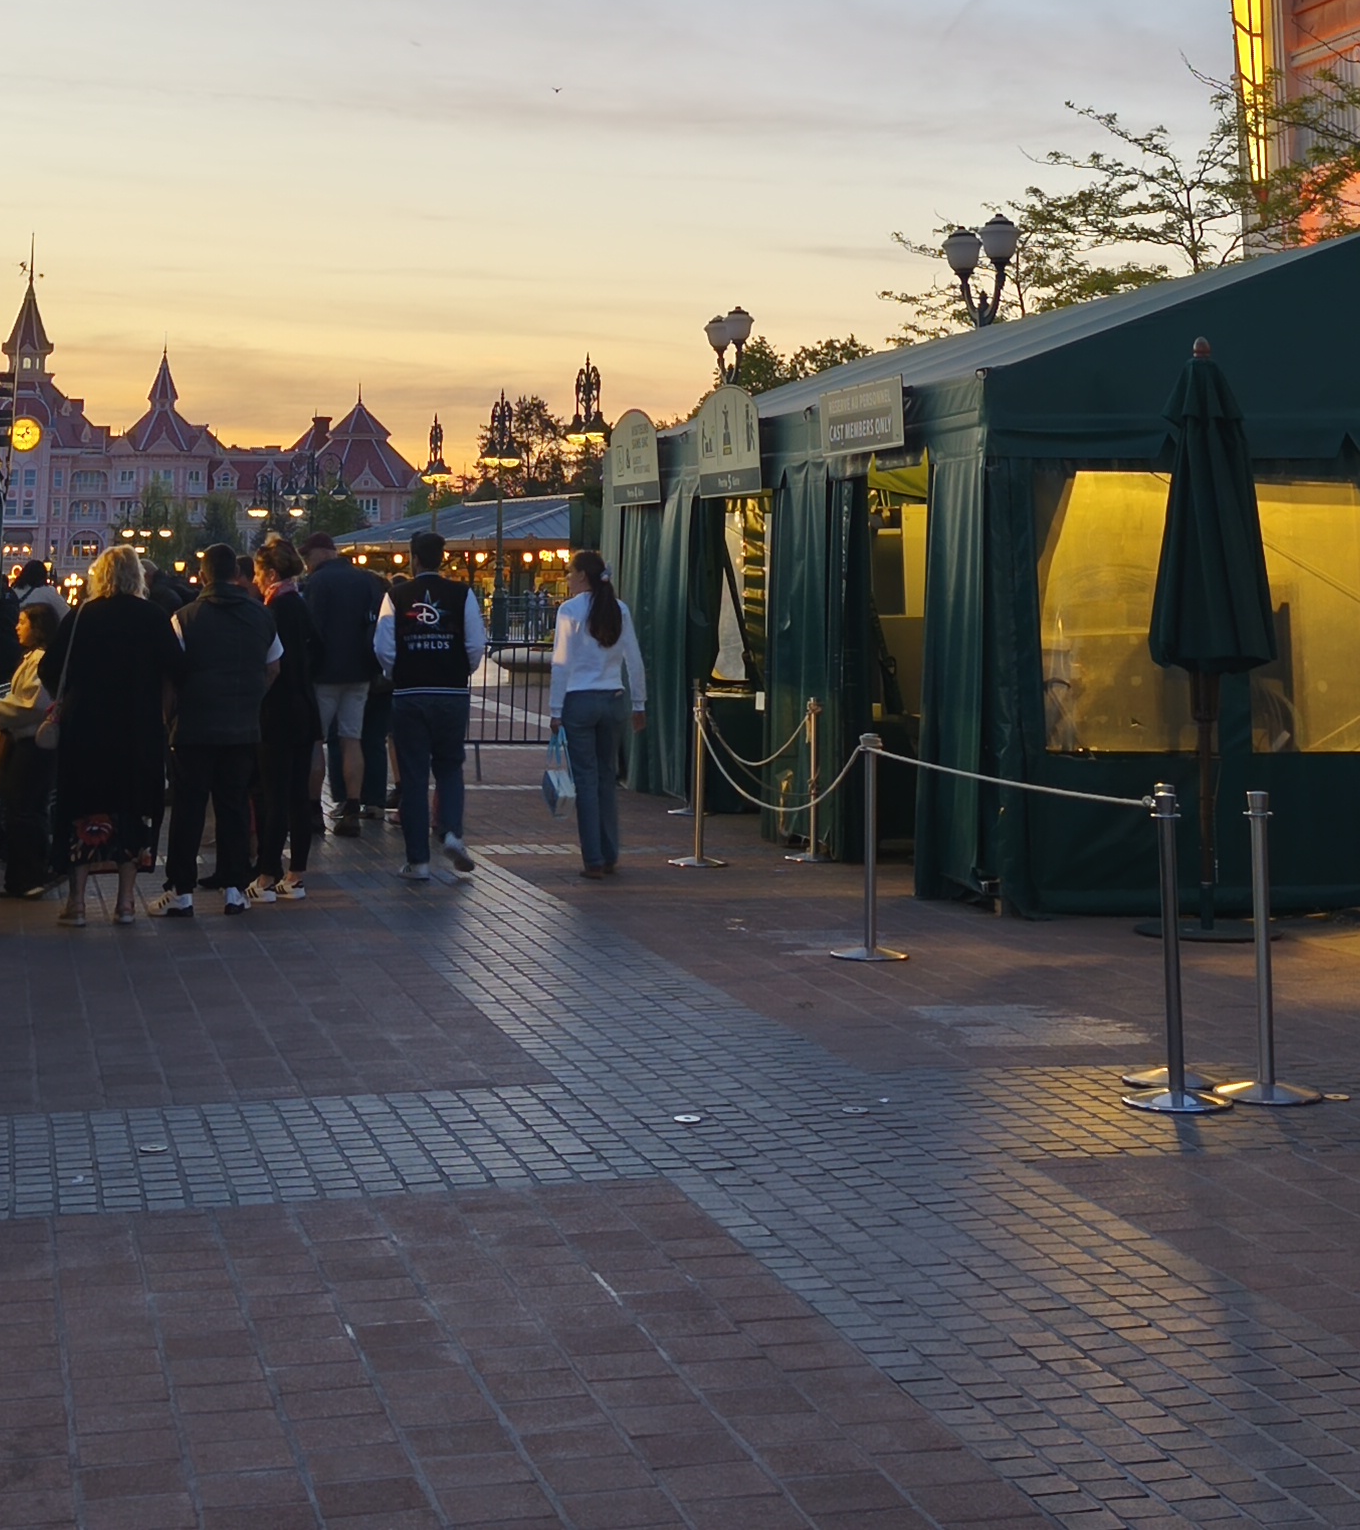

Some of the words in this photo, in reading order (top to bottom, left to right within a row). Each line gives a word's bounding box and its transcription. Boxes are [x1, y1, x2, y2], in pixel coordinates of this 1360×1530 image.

[829, 424, 844, 443] CAST
[845, 419, 874, 439] MEMBERS
[875, 416, 892, 435] ONLY
